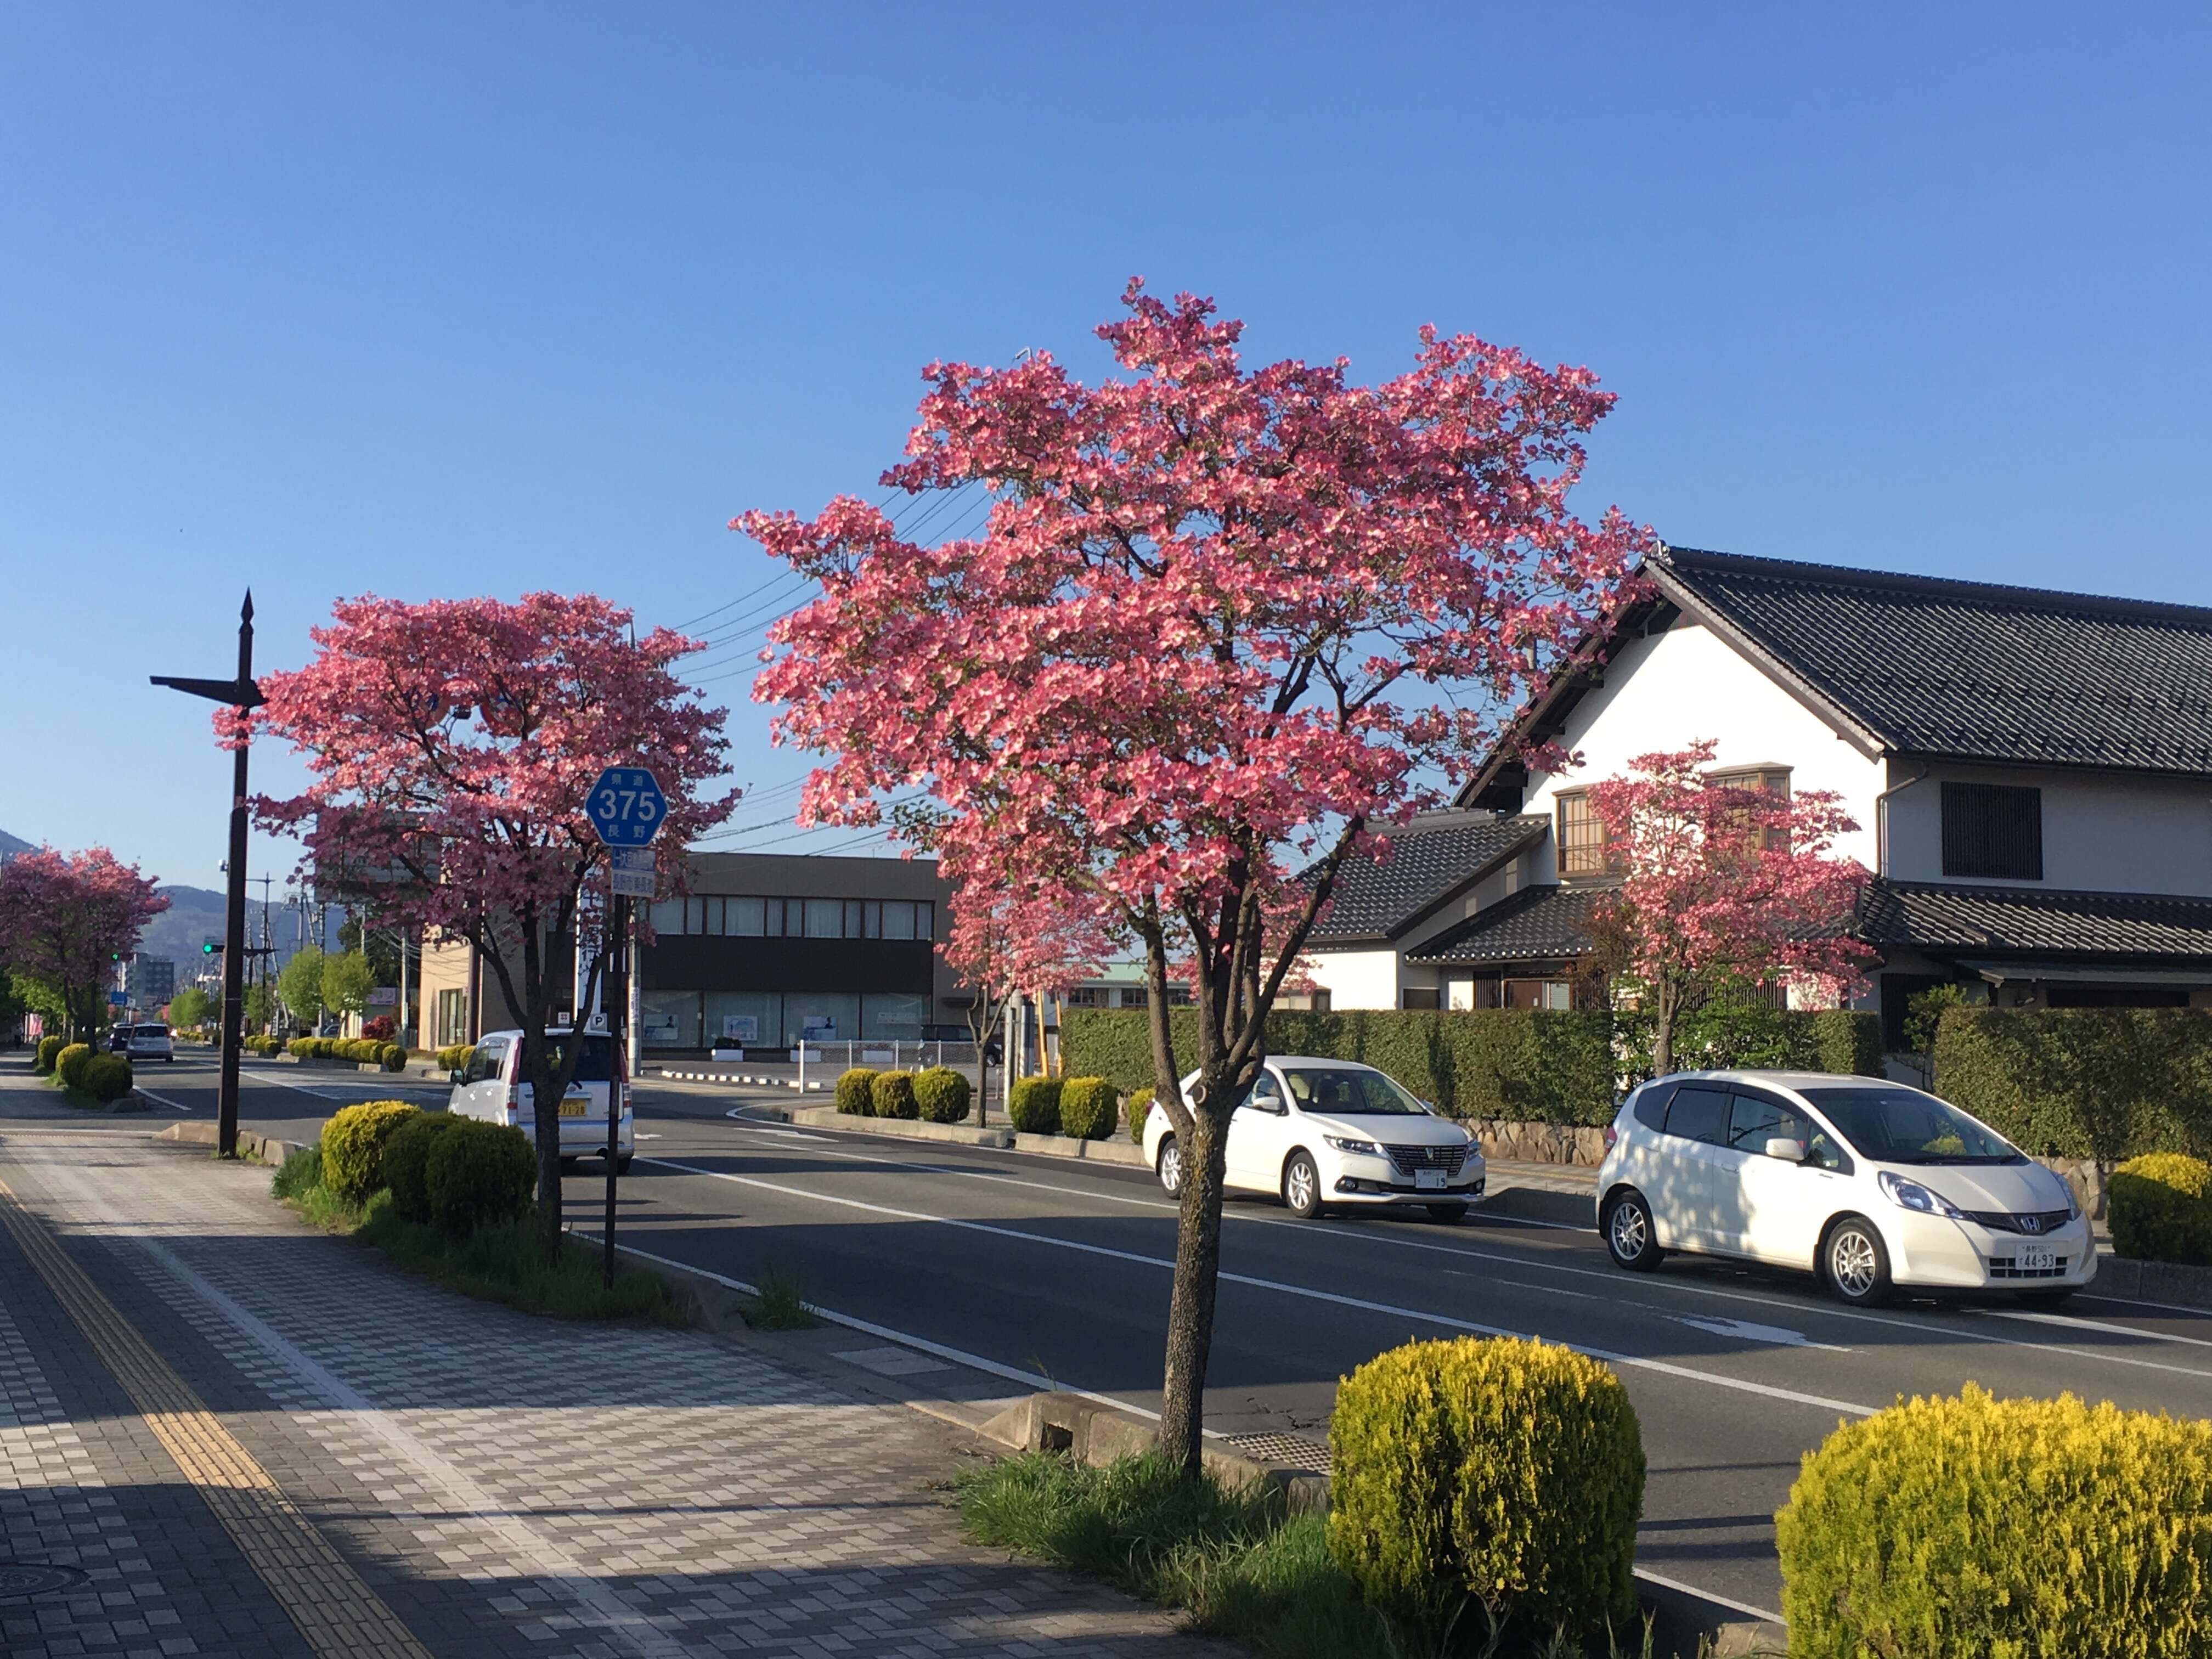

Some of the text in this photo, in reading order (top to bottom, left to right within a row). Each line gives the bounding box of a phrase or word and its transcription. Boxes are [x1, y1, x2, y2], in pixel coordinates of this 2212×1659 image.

[599, 789, 656, 821] 375
[608, 825, 645, 839] 長野
[595, 1016, 602, 1025] P
[2025, 1255, 2054, 1267] 44-93
